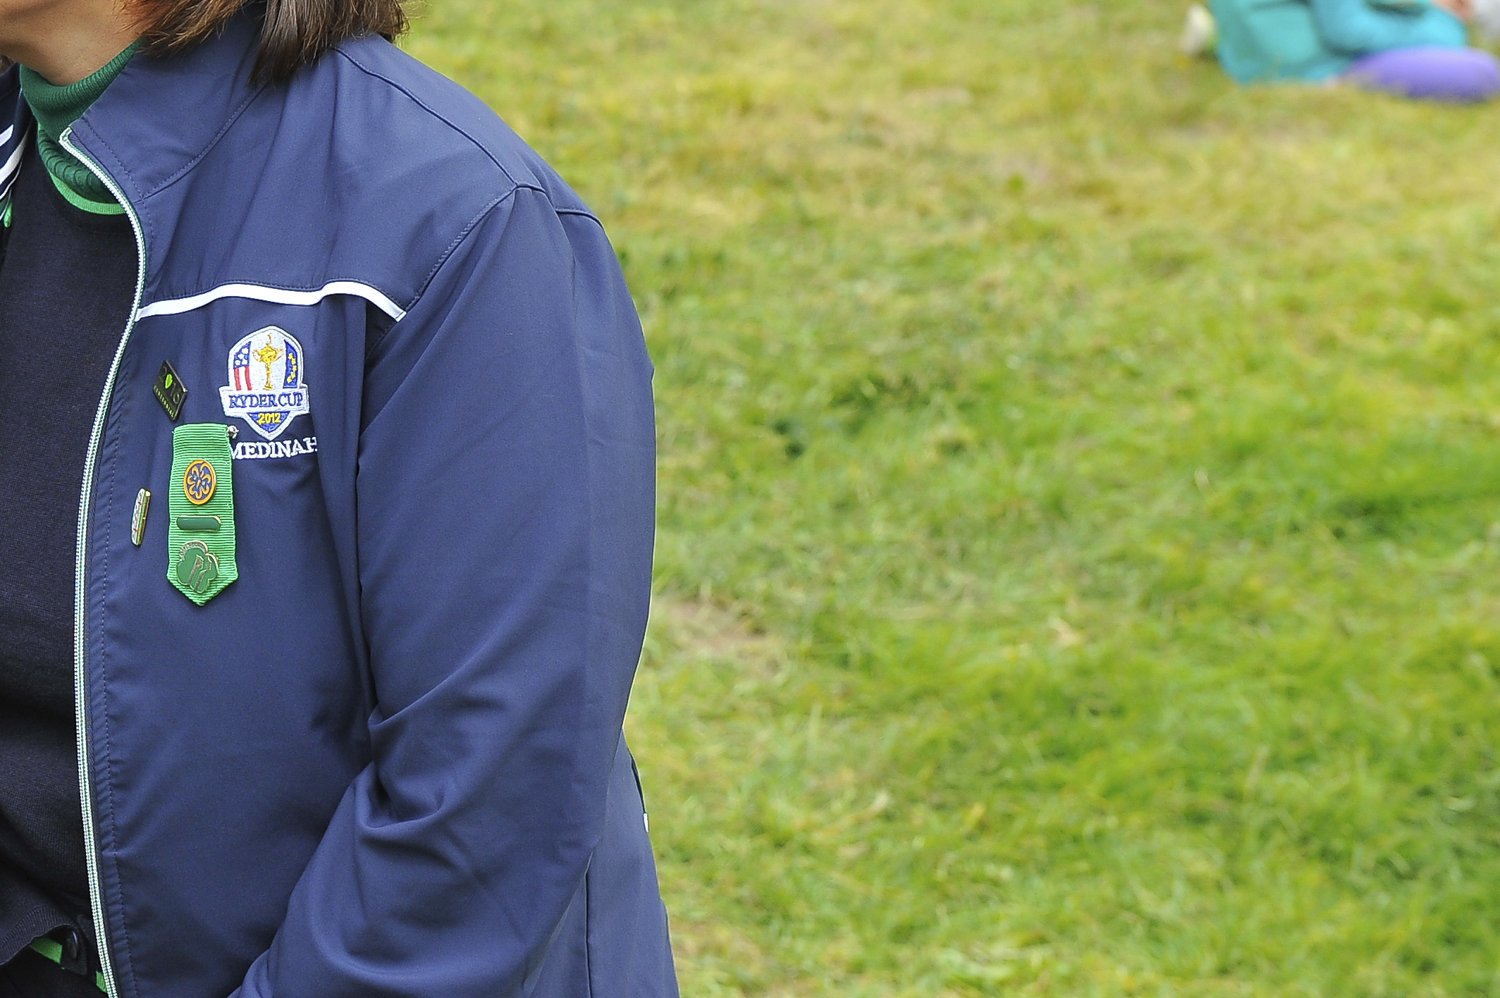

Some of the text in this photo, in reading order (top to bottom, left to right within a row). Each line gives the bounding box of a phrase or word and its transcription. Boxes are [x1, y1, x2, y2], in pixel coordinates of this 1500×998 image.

[228, 392, 304, 409] RYDER CUP
[257, 412, 282, 425] 2012
